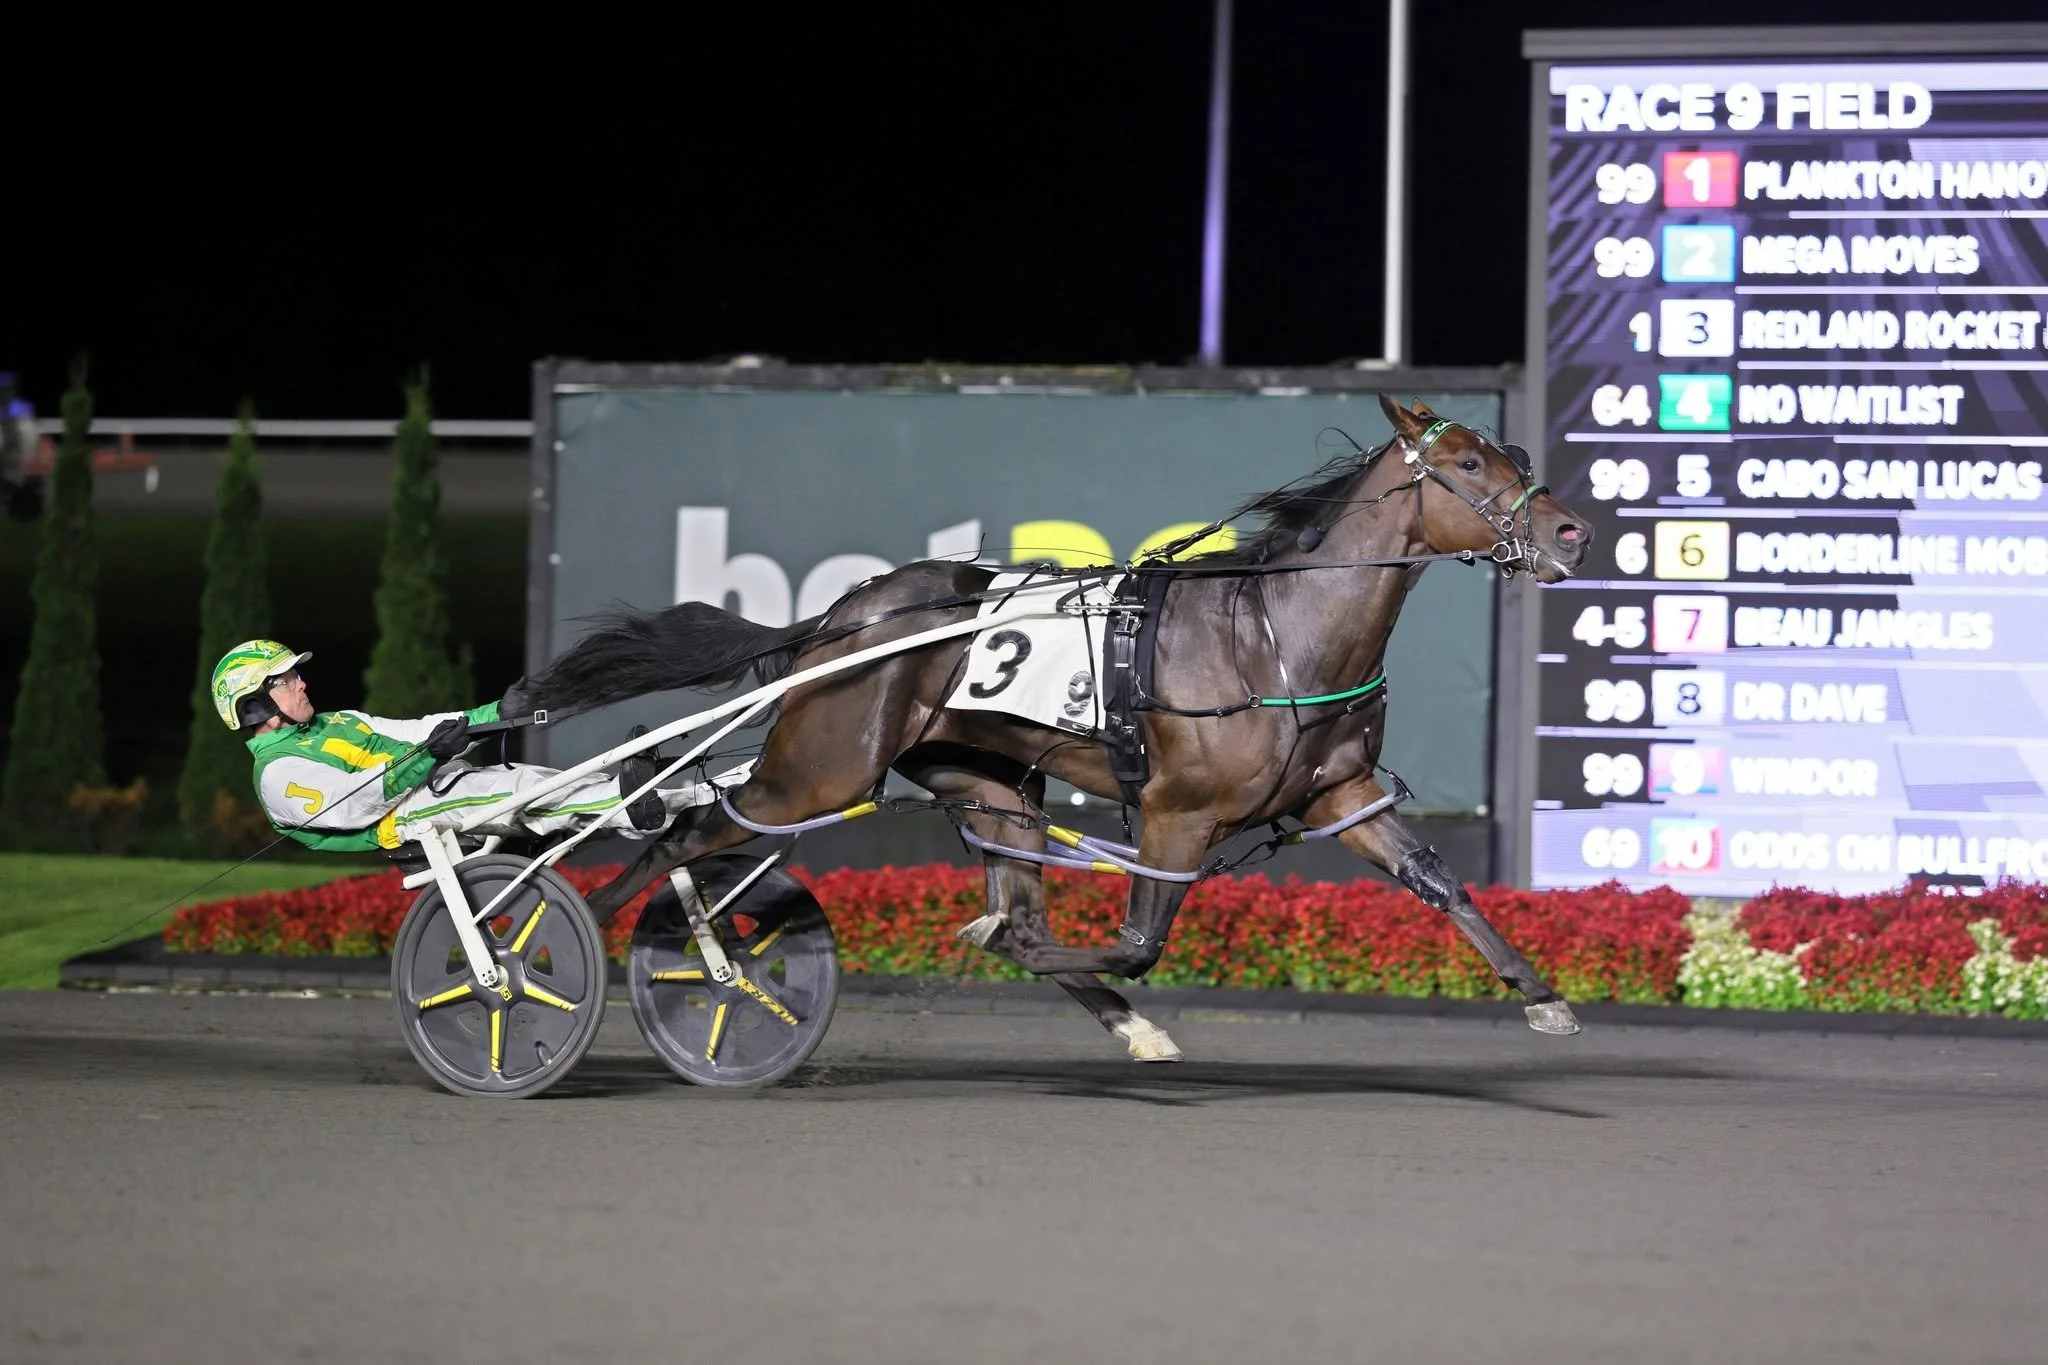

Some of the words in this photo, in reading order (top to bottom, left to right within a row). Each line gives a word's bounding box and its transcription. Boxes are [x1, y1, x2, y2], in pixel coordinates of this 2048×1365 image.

[1566, 84, 1715, 131] RACE
[1725, 83, 1764, 130] 9
[1777, 82, 1932, 130] FIELD
[1596, 163, 1656, 204] 99
[1684, 158, 1710, 202] 1
[1744, 160, 1934, 199] PLANKTON
[1941, 160, 2048, 199] HANO
[1594, 237, 1654, 277] 99
[1681, 234, 1716, 276] 2
[1742, 236, 1848, 274] MEGA
[1850, 235, 1980, 274] MOVES
[1629, 312, 1652, 352] 1
[1687, 311, 1709, 344] 3
[1740, 311, 1899, 348] REDLAND
[1904, 311, 2041, 349] ROCKET
[1592, 385, 1652, 426] 64
[1676, 382, 1712, 423] 4
[1738, 385, 1797, 424] NO
[1798, 385, 1964, 425] WAITLIST
[1590, 459, 1650, 500] 99
[1676, 454, 1711, 497] 5
[1737, 459, 1840, 498] CABO
[1841, 460, 1918, 499] SAN
[1924, 460, 2042, 500] LUCAS
[1615, 532, 1648, 574] 6
[1680, 534, 1704, 567] 6
[1736, 533, 1957, 574] BORDERLINE
[1573, 605, 1646, 648] 4-5
[1681, 609, 1702, 641] 7
[1734, 607, 1833, 647] BEAU
[1833, 608, 1993, 650] JANGLES
[968, 629, 1032, 699] 3
[1584, 679, 1645, 722] 99
[1677, 682, 1701, 715] 8
[1732, 682, 1785, 721] DR
[1790, 683, 1887, 723] DAVE
[1582, 752, 1643, 796] 99
[1669, 750, 1704, 795] 9
[1730, 757, 1879, 797] WINDOR
[285, 781, 324, 815] J
[1581, 827, 1641, 869] 69
[1657, 826, 1713, 868] 10
[1729, 831, 1830, 870] ODDS
[1836, 834, 1890, 871] ON
